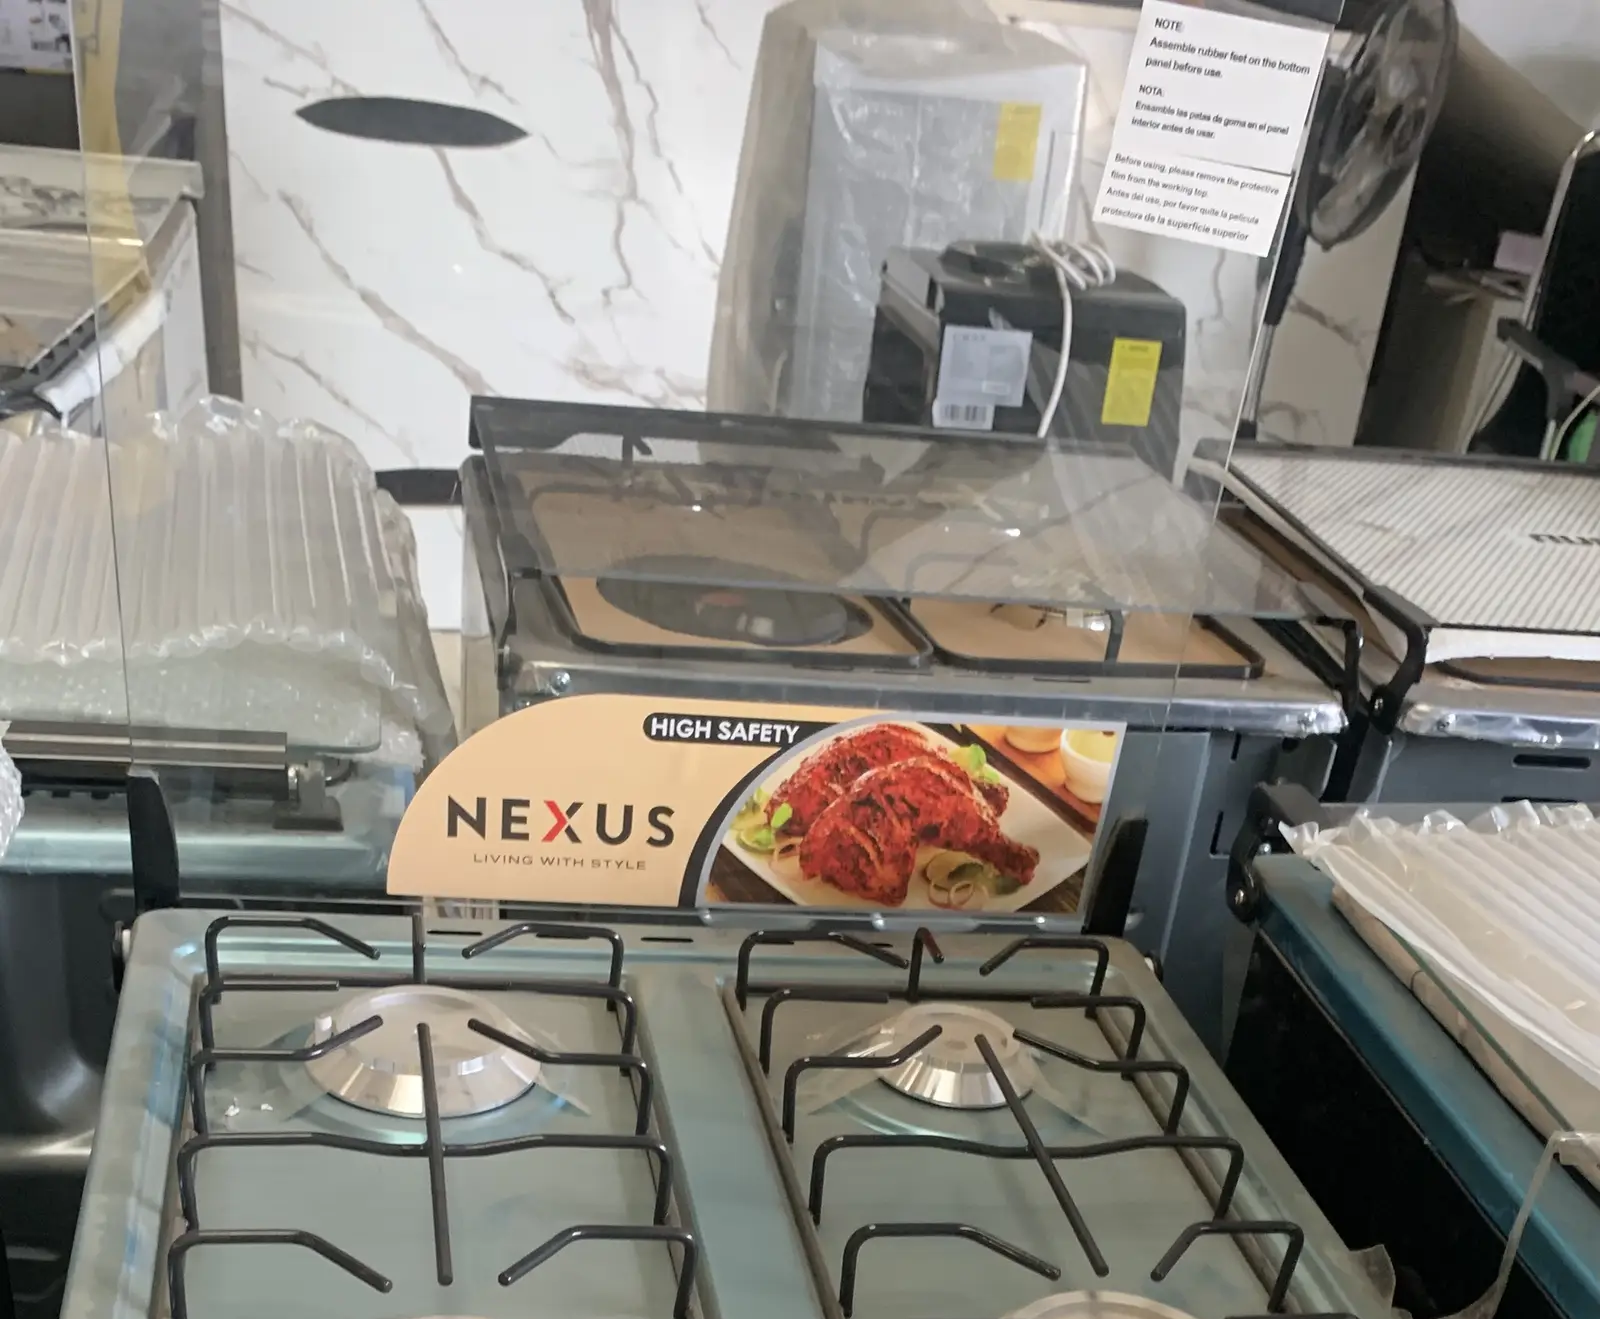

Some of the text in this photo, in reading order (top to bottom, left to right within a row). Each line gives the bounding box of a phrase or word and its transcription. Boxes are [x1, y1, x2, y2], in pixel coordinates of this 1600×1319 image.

[1145, 56, 1222, 78] panel before use.
[1150, 37, 1310, 75] Assemble rubber feet on the bottom
[1135, 100, 1289, 135] Ensamble las patas de goma en el panel
[1162, 122, 1183, 134] antes
[1185, 126, 1194, 135] de
[1196, 129, 1215, 139] usar.
[1111, 170, 1208, 199] film from the working top.
[1115, 153, 1280, 196] Before using, please remove the protective
[1106, 187, 1130, 199] Antes
[1131, 191, 1144, 202] del
[1163, 198, 1177, 209] por
[1178, 200, 1199, 212] favor
[1220, 208, 1228, 218] la
[1101, 205, 1249, 242] protectora de la superficie superior
[651, 717, 800, 744] HIGH SAFETY
[447, 795, 675, 848] NEXUS
[474, 853, 646, 870] LIVING WITH STYLE
